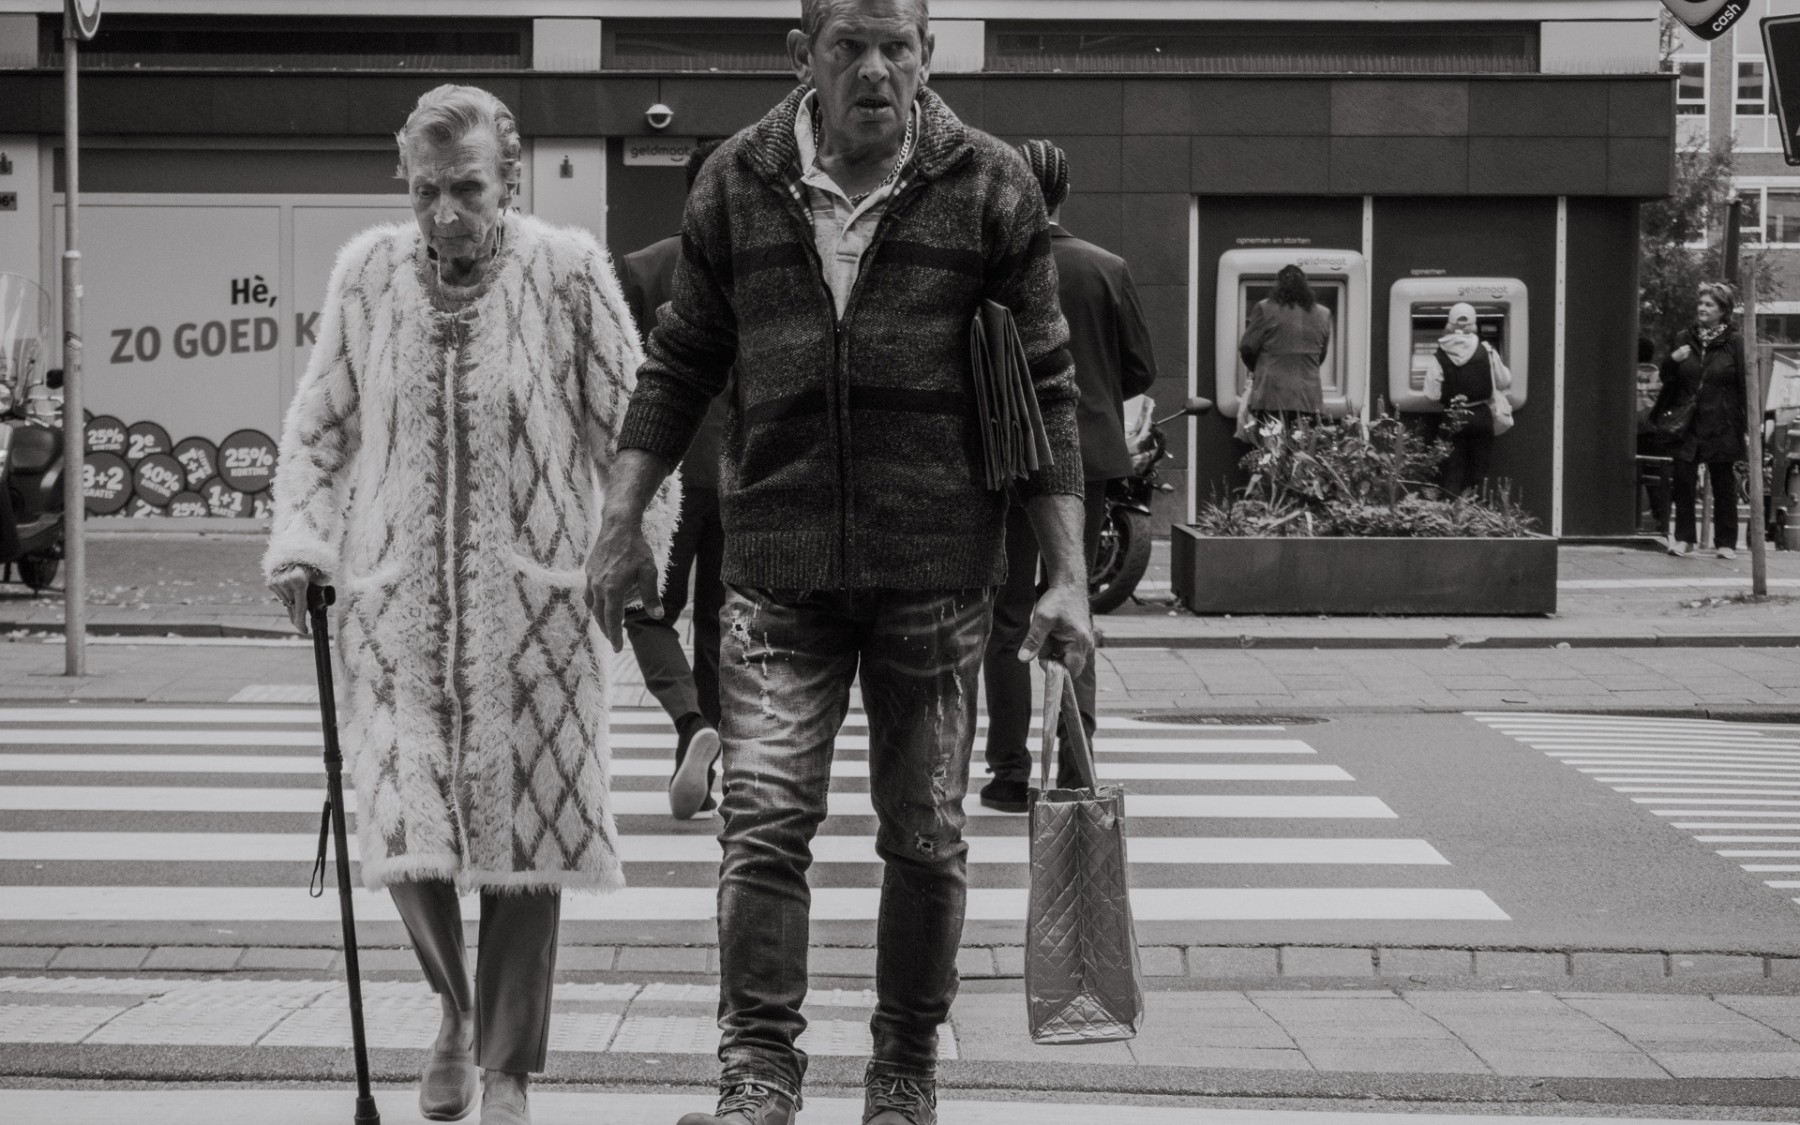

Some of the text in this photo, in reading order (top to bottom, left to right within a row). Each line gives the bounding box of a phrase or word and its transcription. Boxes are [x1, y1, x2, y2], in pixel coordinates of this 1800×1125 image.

[1712, 3, 1741, 31] cash
[630, 144, 690, 159] geldmaat
[1296, 256, 1348, 268] geldmaat
[231, 274, 278, 308] Hè,
[1457, 285, 1509, 297] geldmaat
[110, 325, 161, 364] ZO
[173, 316, 279, 359] GOED
[88, 428, 124, 444] 25%
[225, 446, 274, 468] 25%
[83, 464, 124, 491] 3+2
[140, 462, 180, 492] 40%
[230, 467, 269, 476] KORTING
[172, 502, 206, 517] 25%
[208, 485, 244, 512] 1+1
